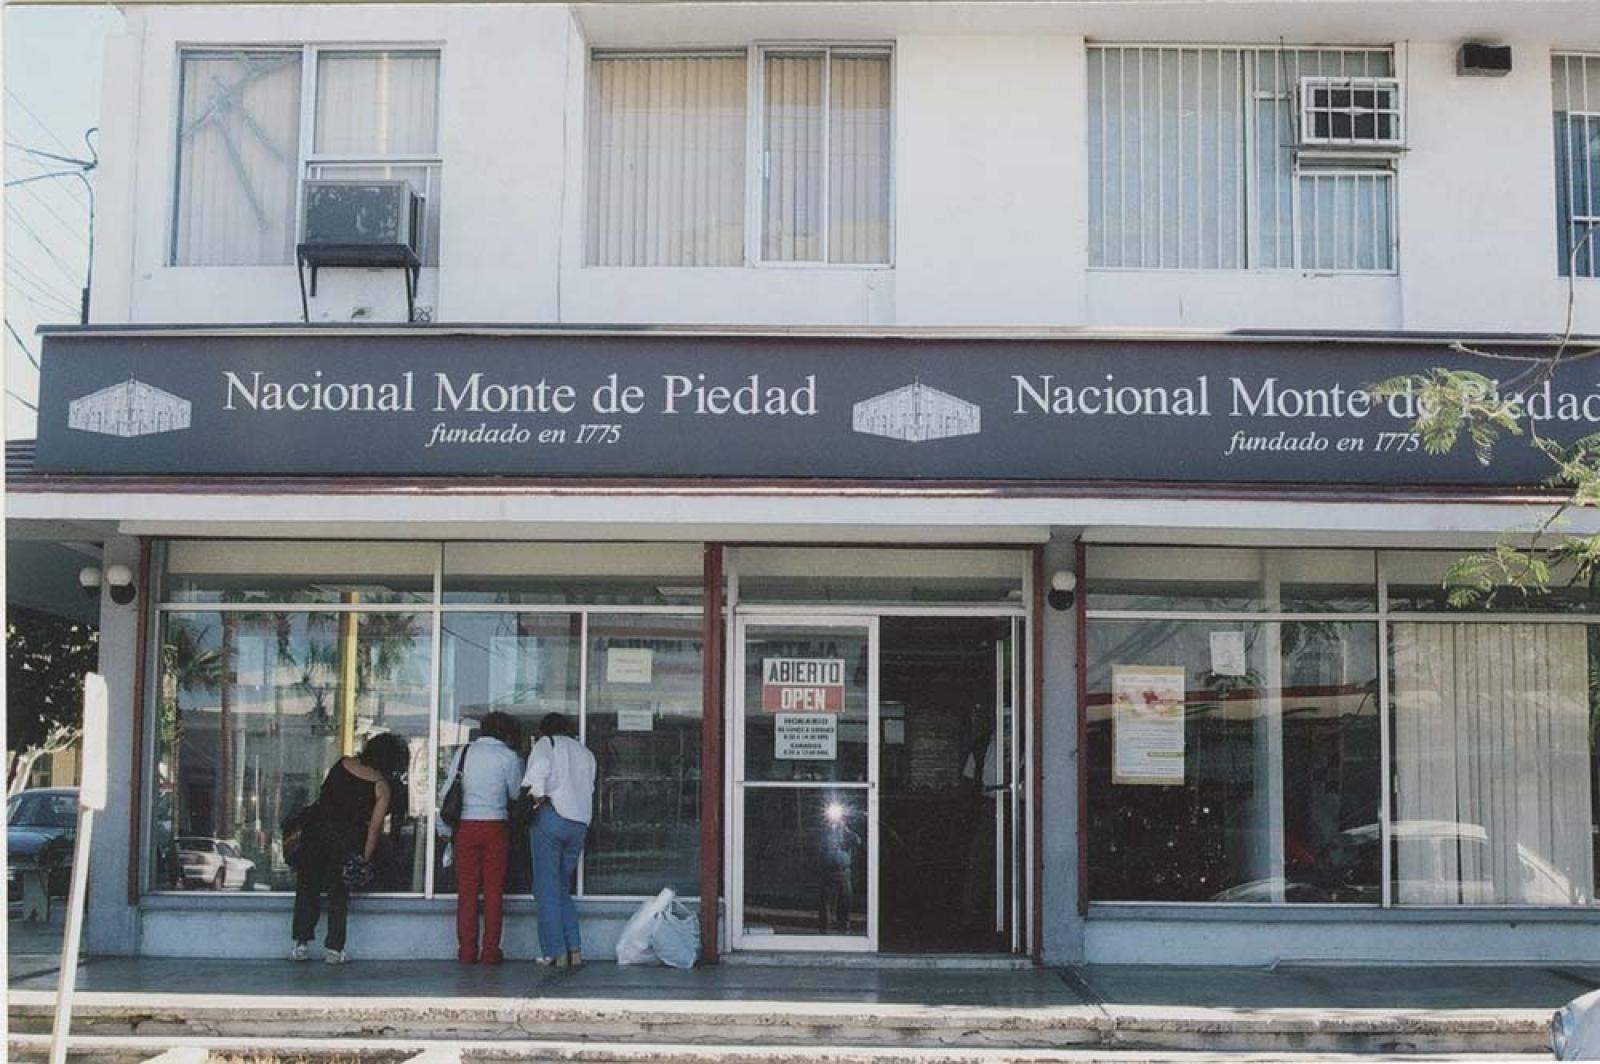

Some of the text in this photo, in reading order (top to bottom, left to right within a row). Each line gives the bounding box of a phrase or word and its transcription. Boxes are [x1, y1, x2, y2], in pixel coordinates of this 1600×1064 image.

[222, 370, 819, 415] Nacional Monte de Piedad
[1011, 374, 1211, 416] Nacional
[1229, 376, 1371, 419] Monte
[424, 423, 622, 448] fundado en 1775
[1223, 430, 1420, 456] fundado en 1775
[769, 661, 839, 683] ABIERTO
[782, 688, 826, 710] OPEN
